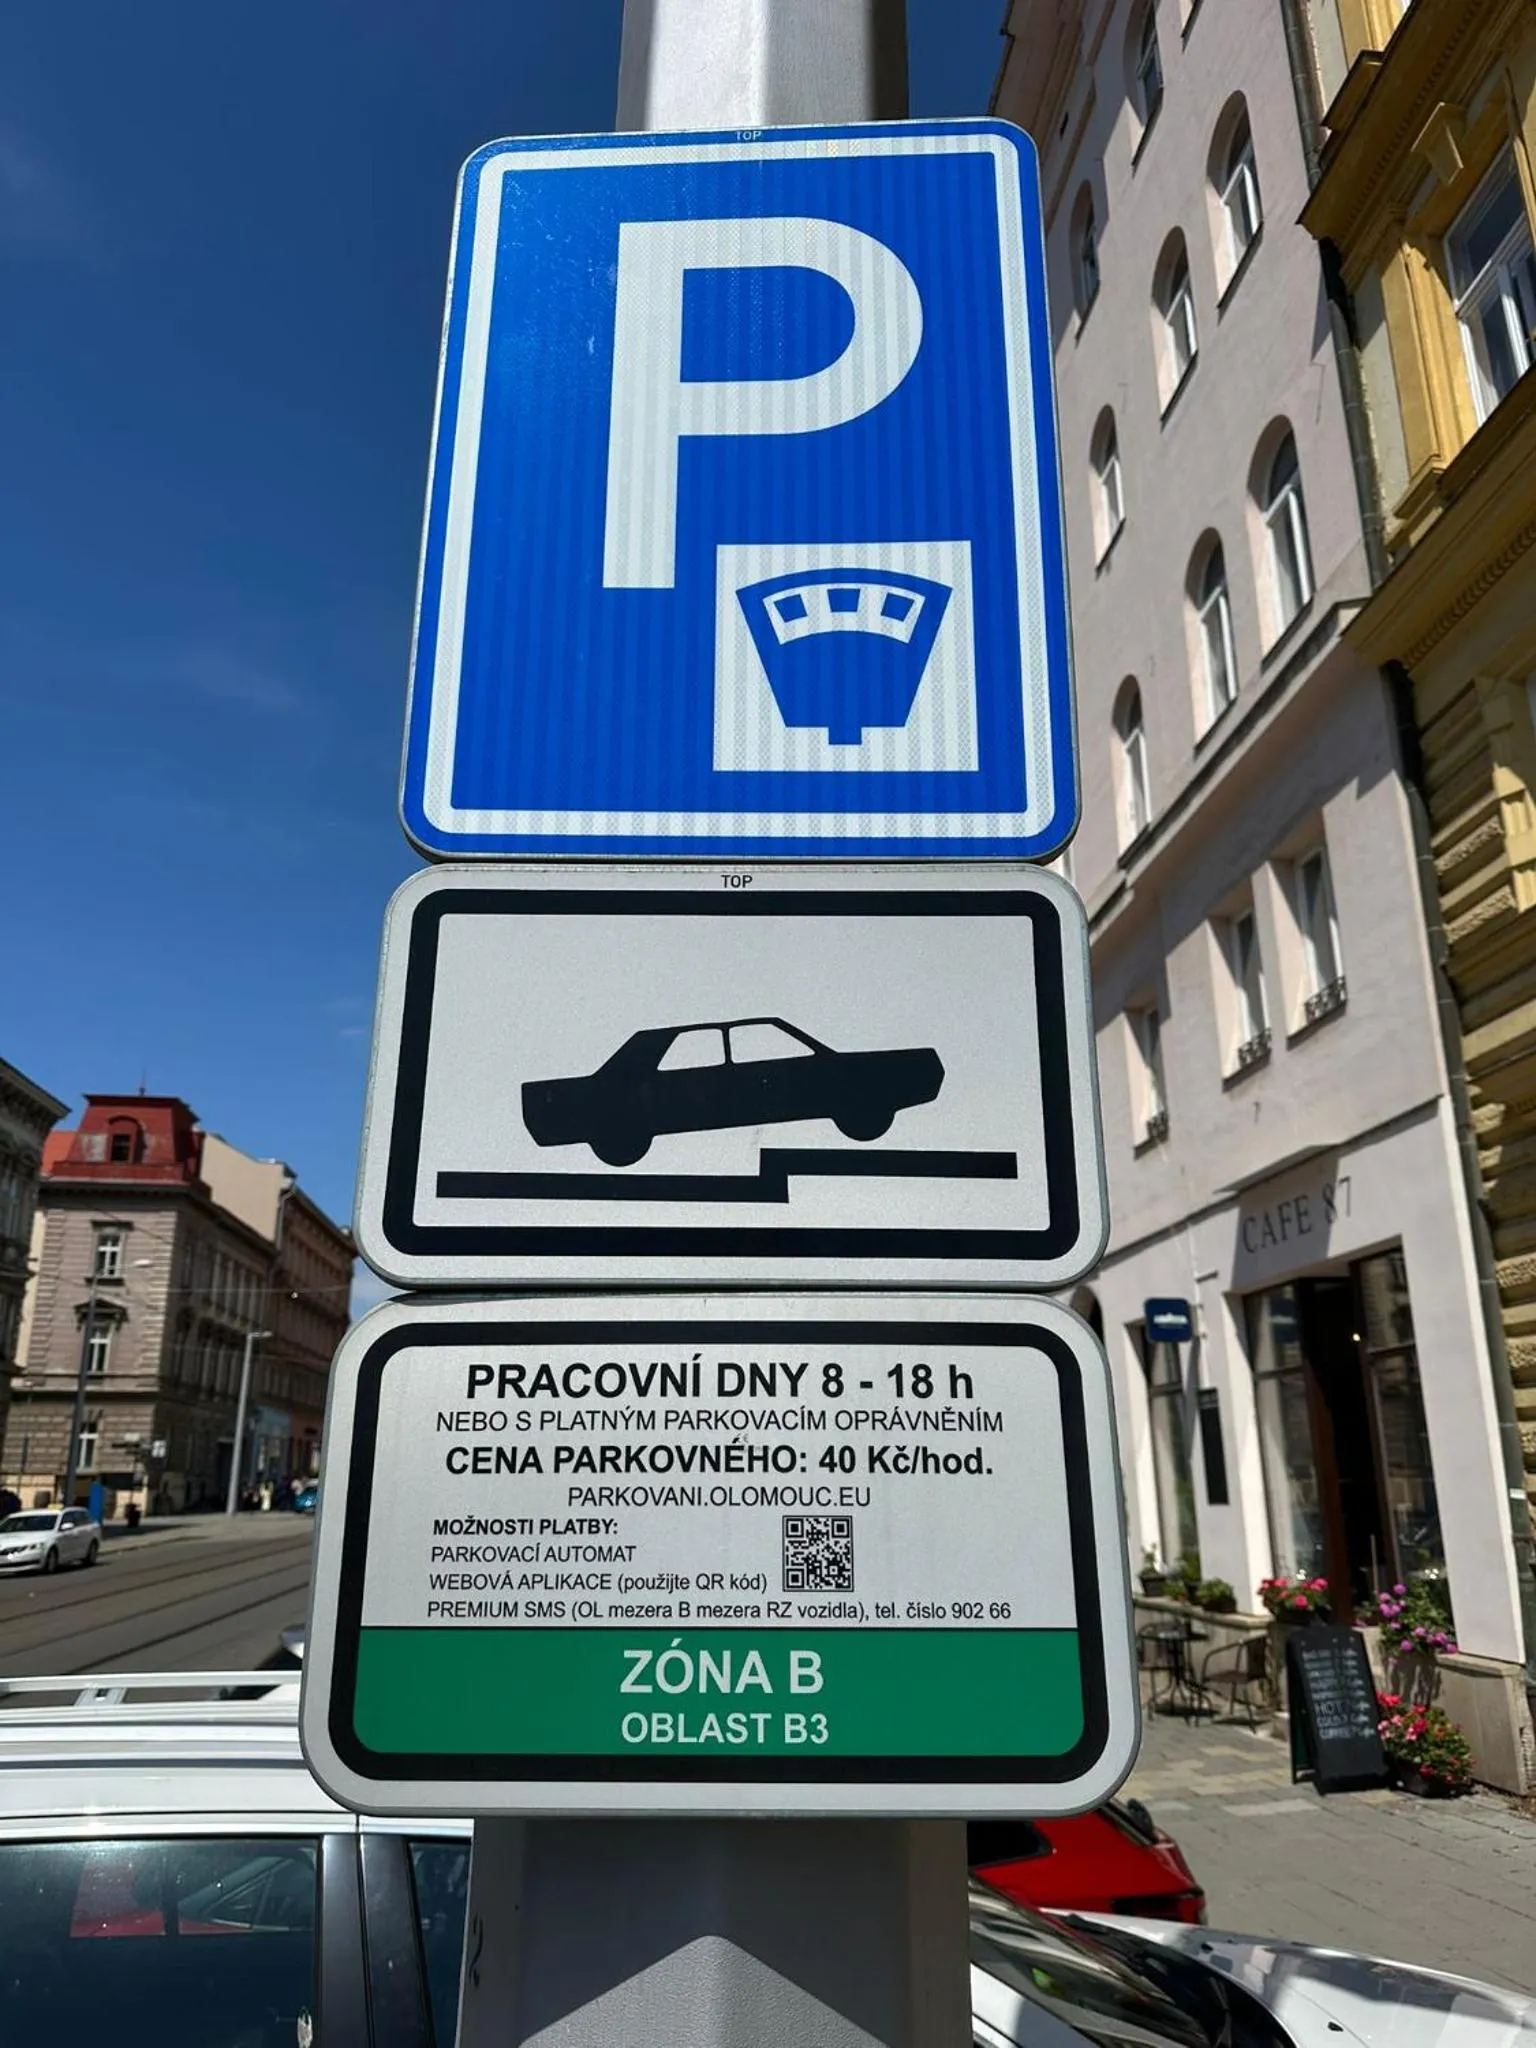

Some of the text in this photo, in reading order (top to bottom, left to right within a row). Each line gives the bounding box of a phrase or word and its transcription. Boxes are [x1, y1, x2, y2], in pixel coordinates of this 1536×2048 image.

[735, 130, 762, 141] TOP
[602, 216, 924, 589] P
[720, 874, 753, 889] TOP
[1242, 1175, 1351, 1254] CAFE 87
[467, 1353, 973, 1399] PRACOVNÍ DNY 8 - 18 h
[436, 1405, 1003, 1433] NEBO S PLATNÝM PARKOVACÍM OPRÁVNĚNÍM
[446, 1436, 993, 1476] CENA PARKOVNÉHO: 40 Kč/hod.
[568, 1486, 871, 1507] PARKOVANI.OLOMOUC.EU
[433, 1515, 618, 1536] MOŽNOSTI PLATBY:
[431, 1543, 637, 1563] PARKOVACÍ AUTOMAT
[429, 1570, 768, 1595] WEBOVÁ APLIKACE (použijte QR kód)
[427, 1600, 1012, 1623] PREMIUM SMS (OL mezera B mezera RZ vozidla), tel. číslo 902 66
[619, 1637, 825, 1694] ZÓNA B
[621, 1711, 829, 1745] OBLAST B3
